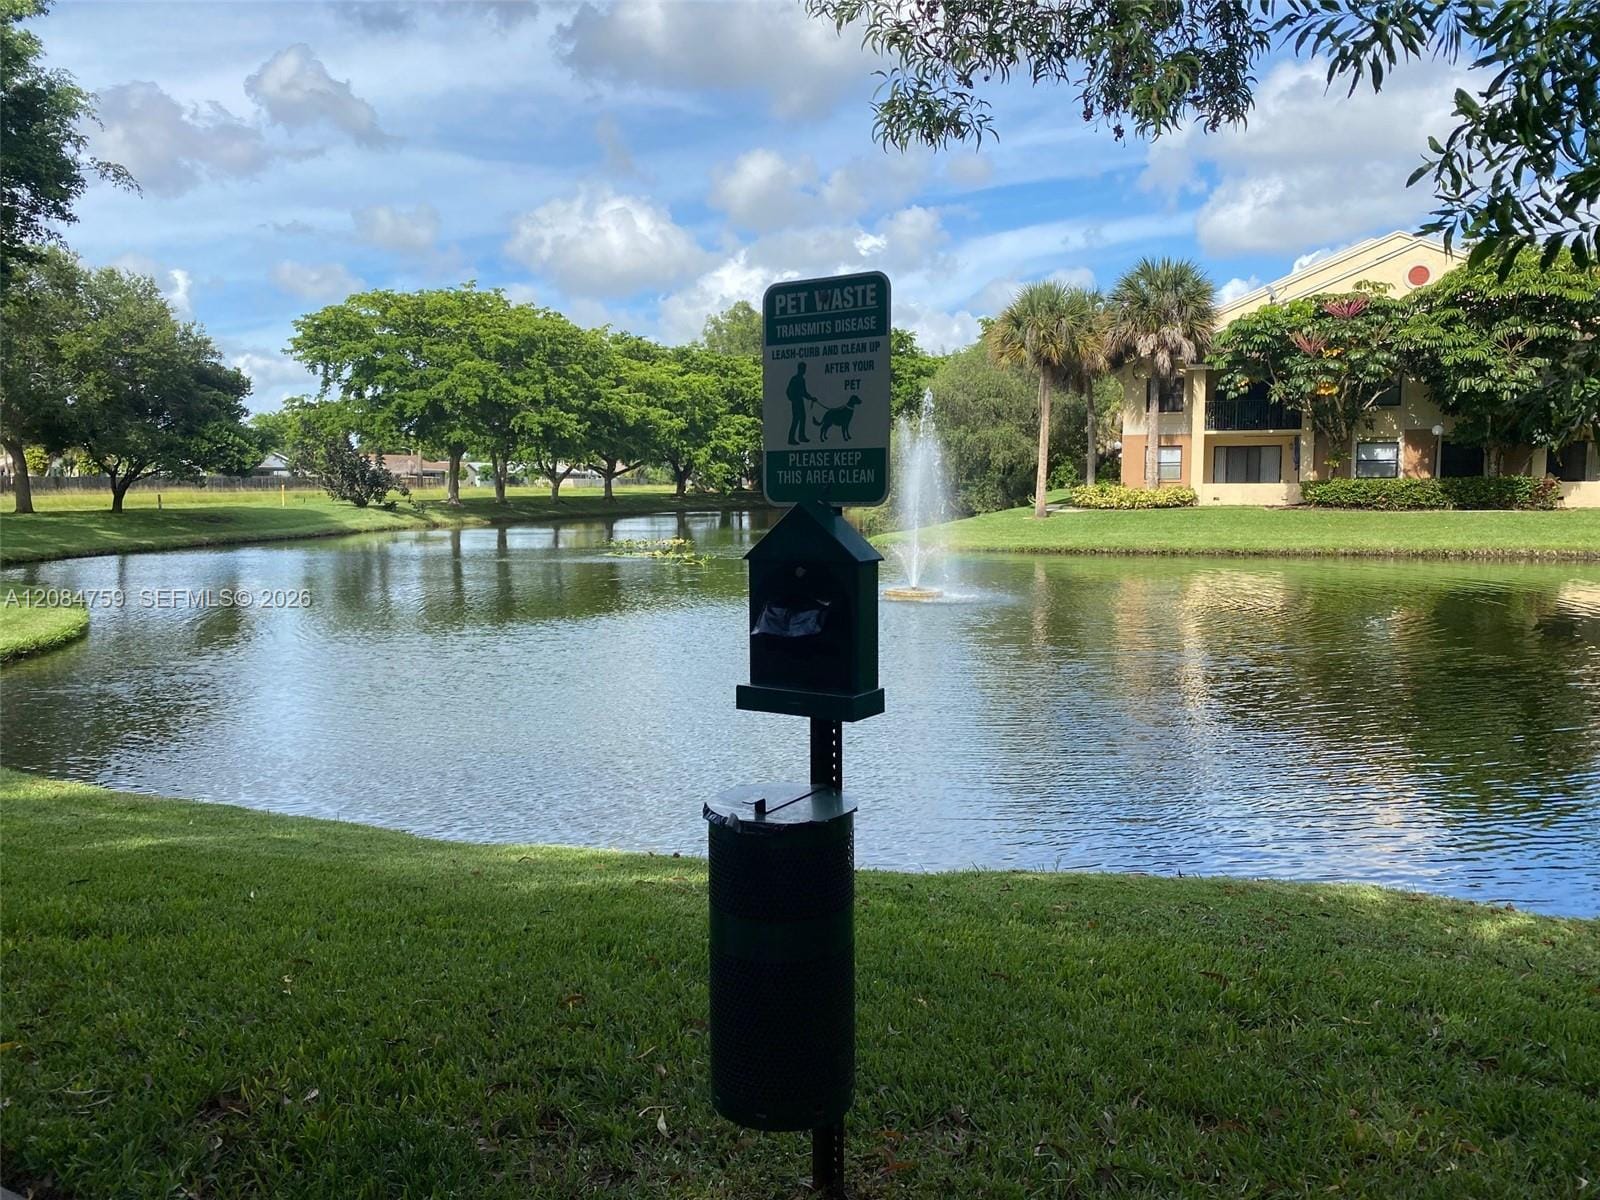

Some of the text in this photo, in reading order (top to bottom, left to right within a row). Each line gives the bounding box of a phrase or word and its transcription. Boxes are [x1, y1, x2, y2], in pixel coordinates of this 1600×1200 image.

[775, 284, 877, 315] PET WASTE
[776, 316, 876, 338] TRANSMITS DISEASE
[772, 341, 880, 360] LEASH-CURB AND CLEAN UP
[824, 360, 874, 375] AFTER YOUR
[844, 379, 861, 391] PET
[789, 452, 862, 467] PLEASE KEEP
[777, 469, 874, 484] THIS AREA CLEAN
